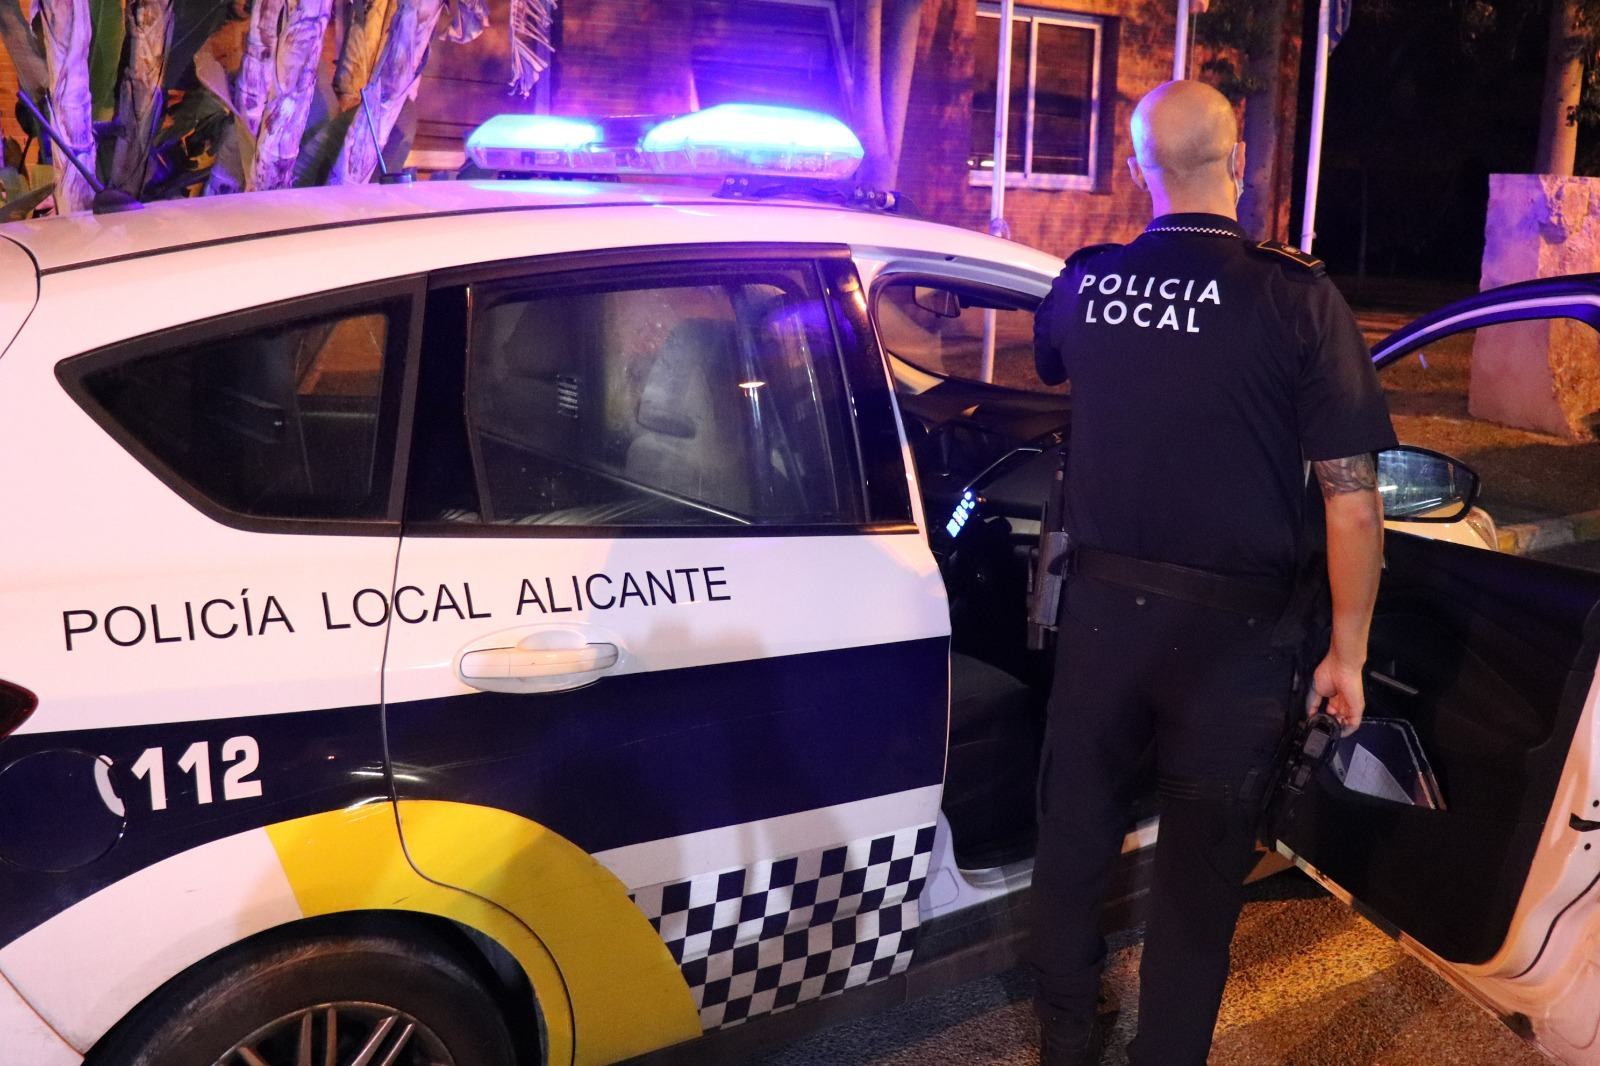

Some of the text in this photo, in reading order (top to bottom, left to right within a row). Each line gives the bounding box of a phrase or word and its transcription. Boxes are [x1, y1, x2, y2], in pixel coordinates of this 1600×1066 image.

[1078, 274, 1221, 305] POLICIA
[1085, 300, 1200, 333] LOCAL
[62, 566, 732, 651] POLICÍA LOCAL ALICANTE
[131, 735, 262, 811] 112
